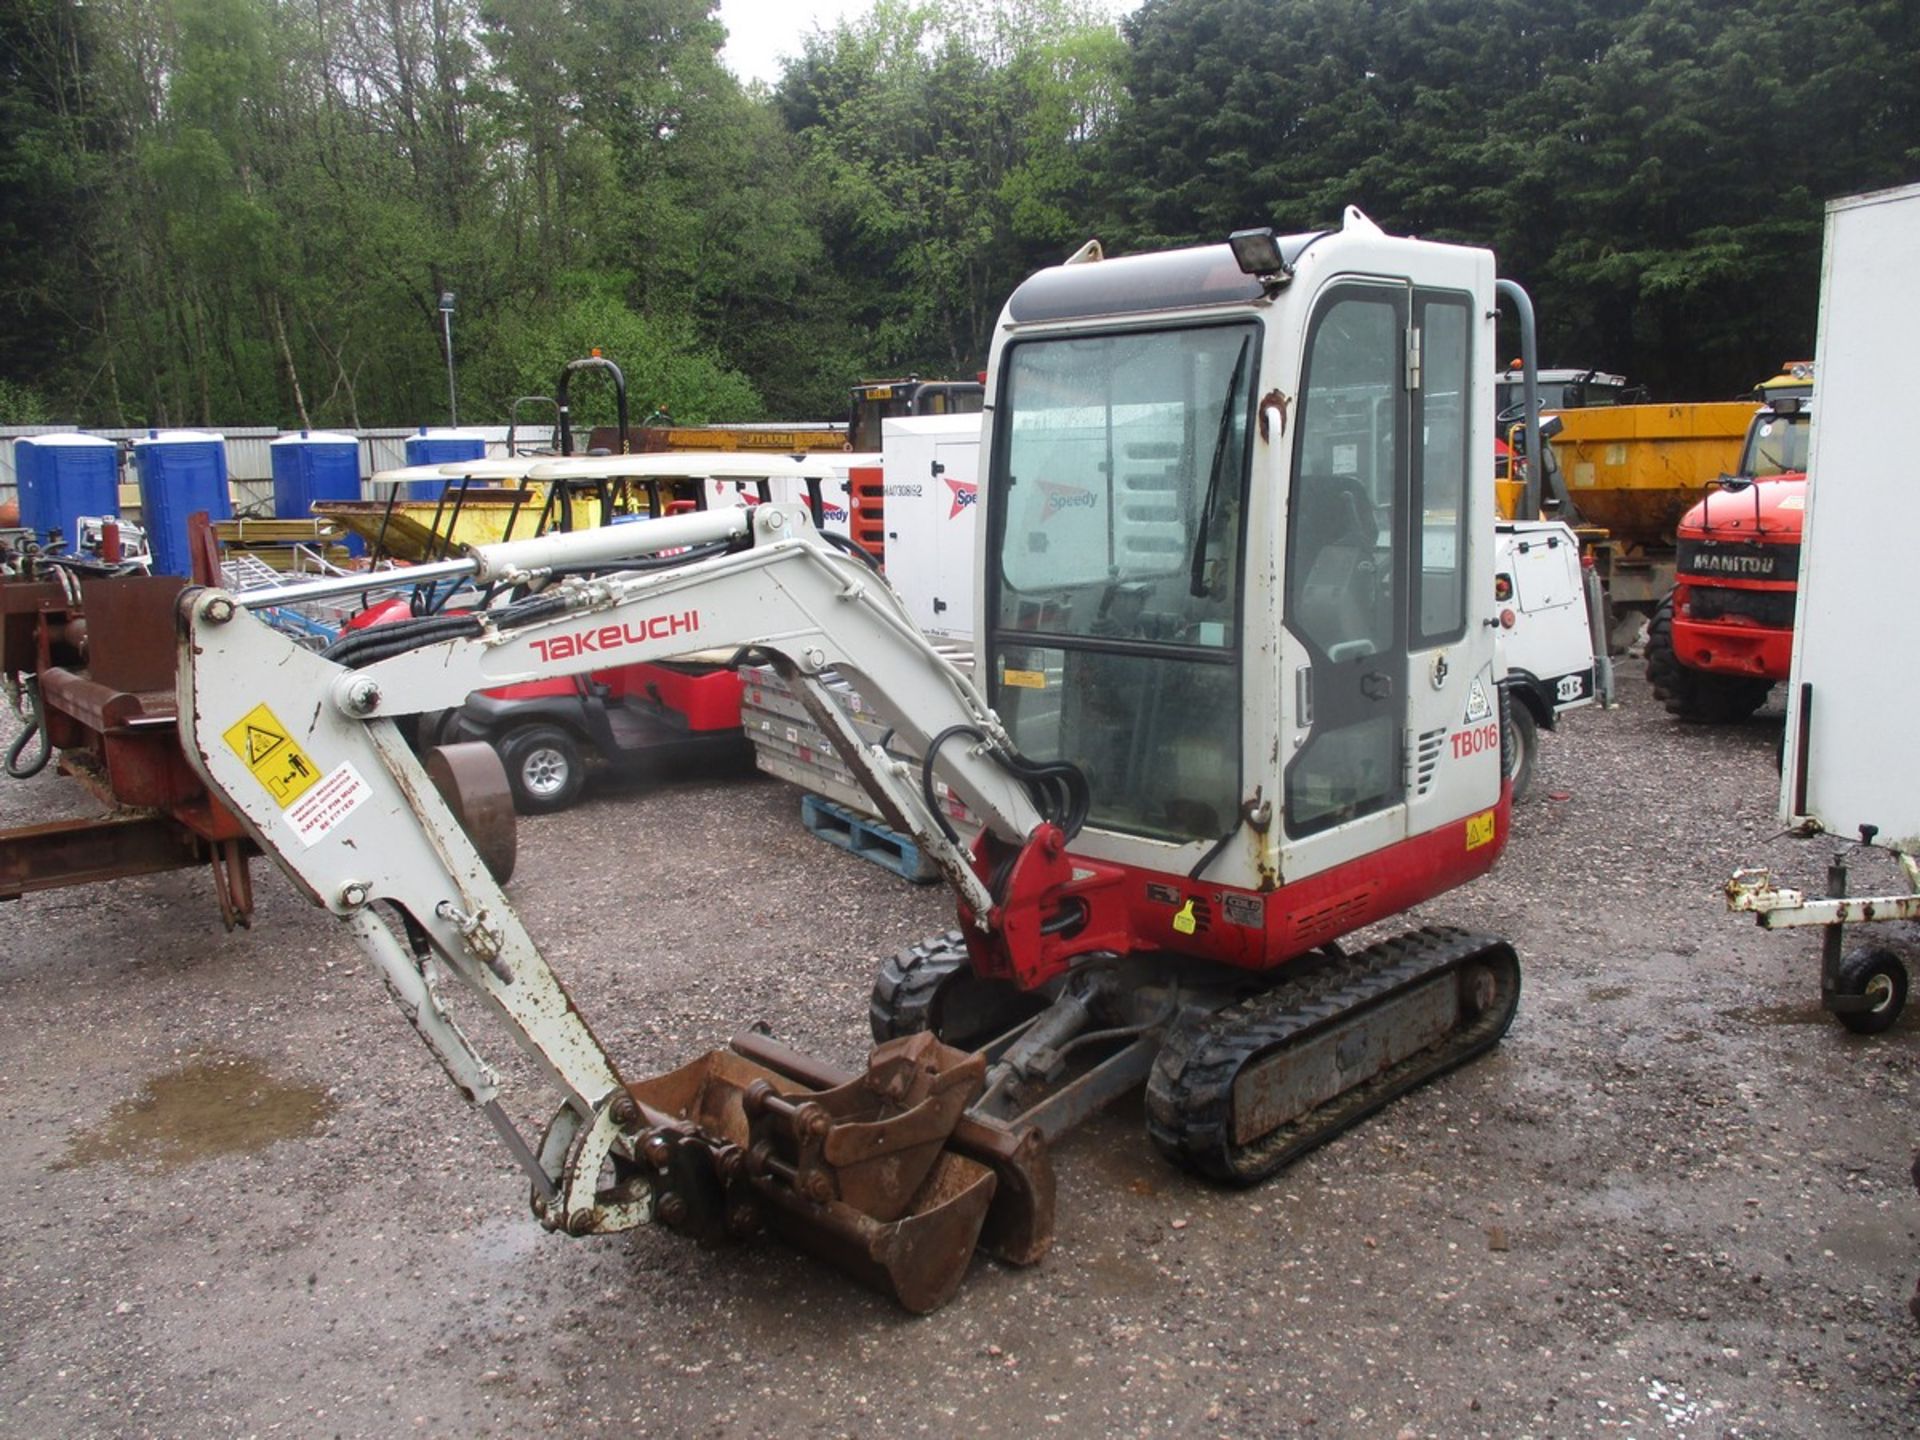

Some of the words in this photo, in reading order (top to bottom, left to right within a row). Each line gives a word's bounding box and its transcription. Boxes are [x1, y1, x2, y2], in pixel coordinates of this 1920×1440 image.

[1049, 491, 1099, 512] Speedy
[1693, 553, 1775, 574] MANITOU
[1450, 723, 1498, 760] TB016
[301, 808, 328, 834] SAFETY
[327, 796, 342, 811] PIN
[340, 780, 361, 799] MUST
[329, 798, 354, 821] FITTED
